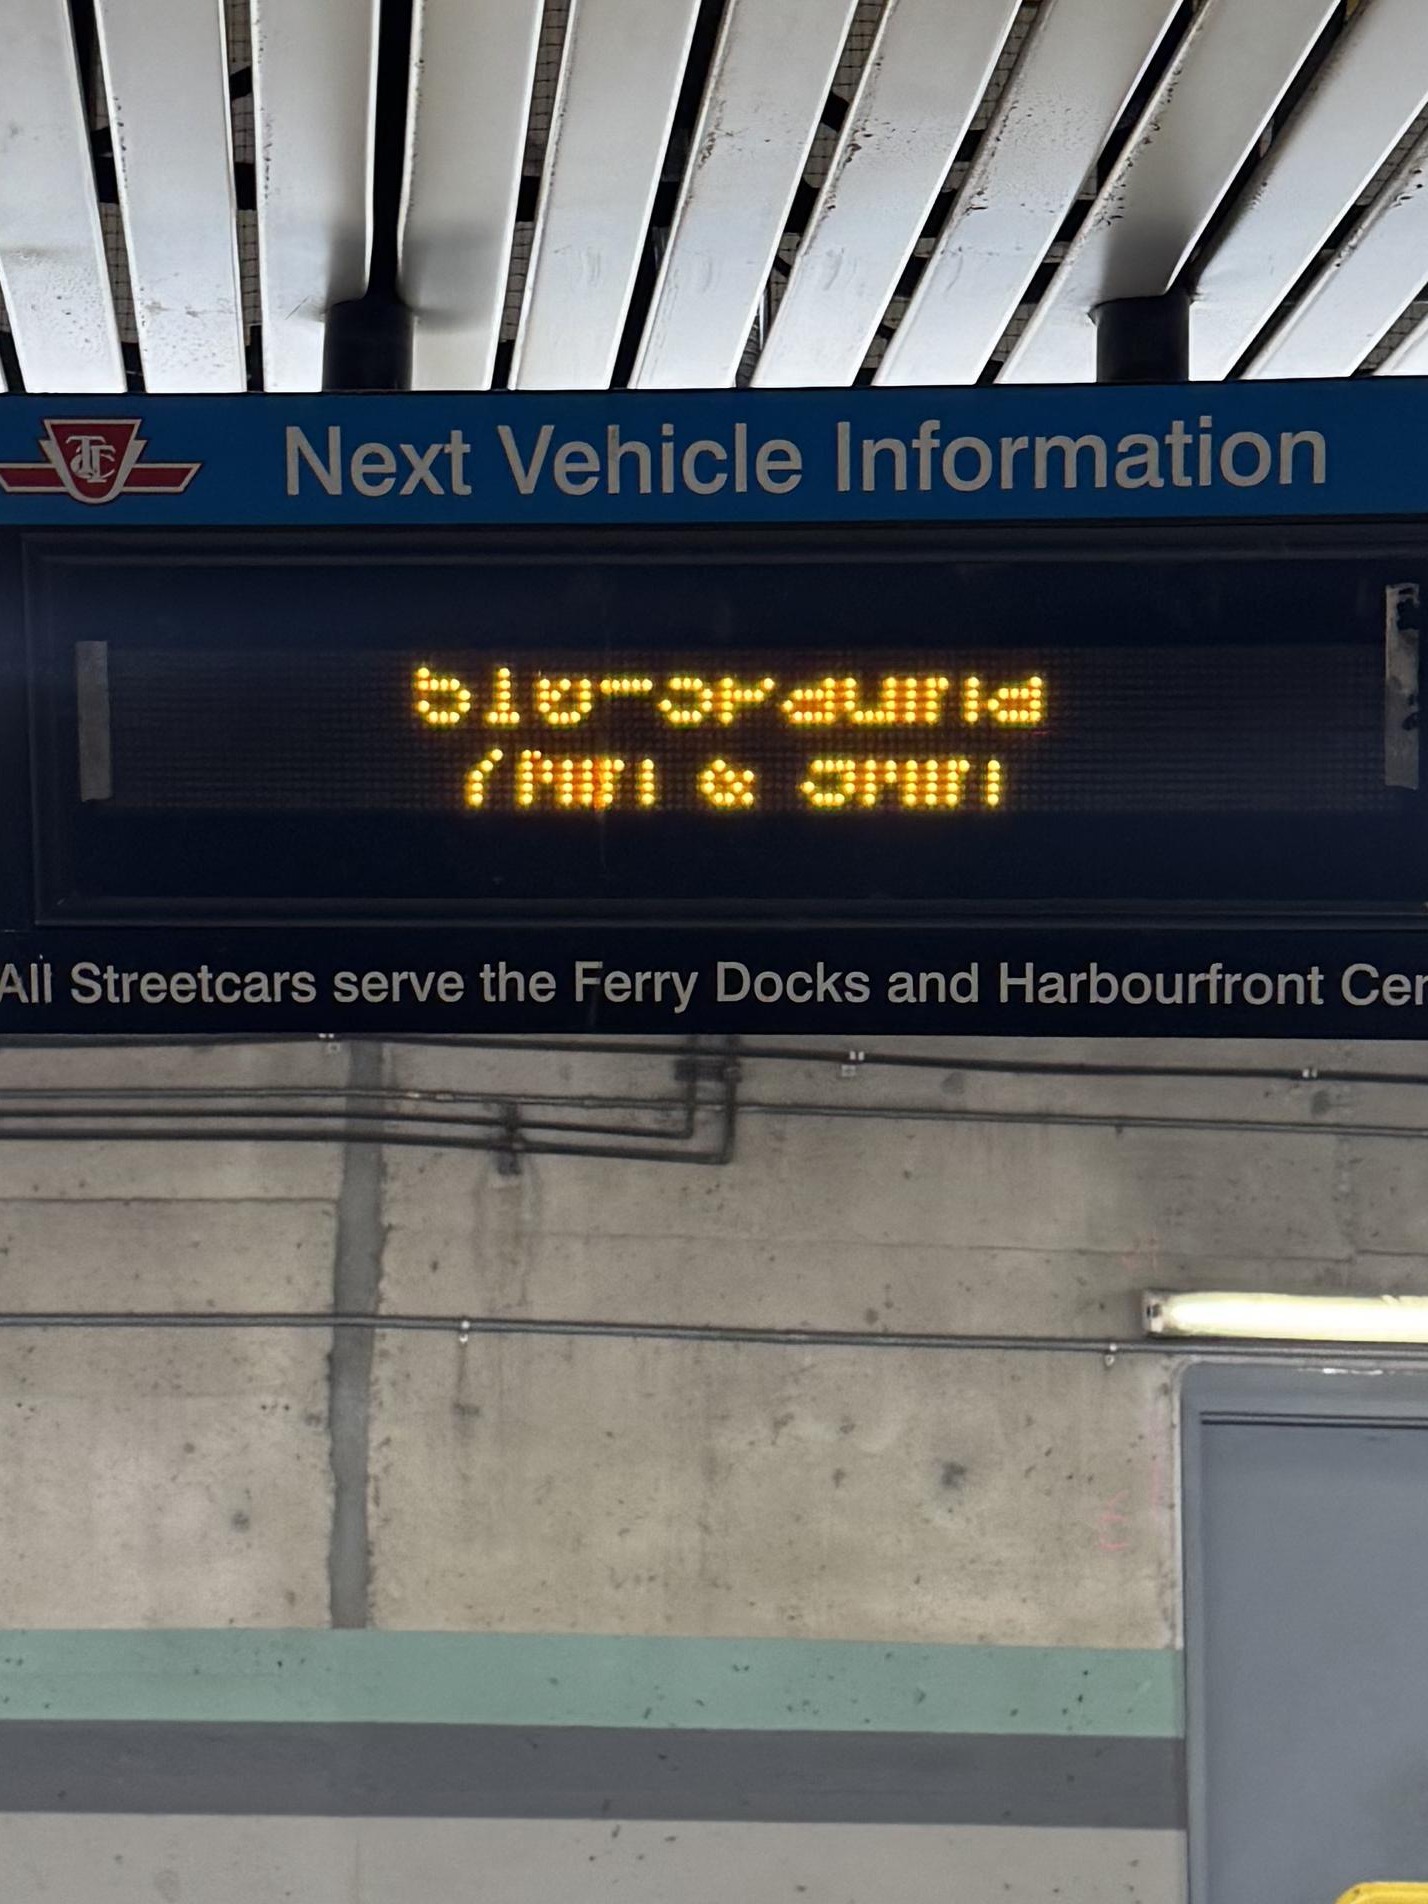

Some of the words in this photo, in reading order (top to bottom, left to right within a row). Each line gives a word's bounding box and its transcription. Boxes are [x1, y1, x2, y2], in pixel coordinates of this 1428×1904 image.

[285, 424, 472, 496] Next
[496, 421, 804, 496] Vehicle
[836, 415, 1327, 492] Information
[69, 960, 318, 1004] Streetcars
[332, 968, 466, 1004] serve
[479, 962, 557, 1003] the
[572, 960, 700, 1014] Ferry
[715, 960, 871, 1005] Docks
[887, 960, 980, 1005] and
[998, 960, 1326, 1007] Harbourfront
